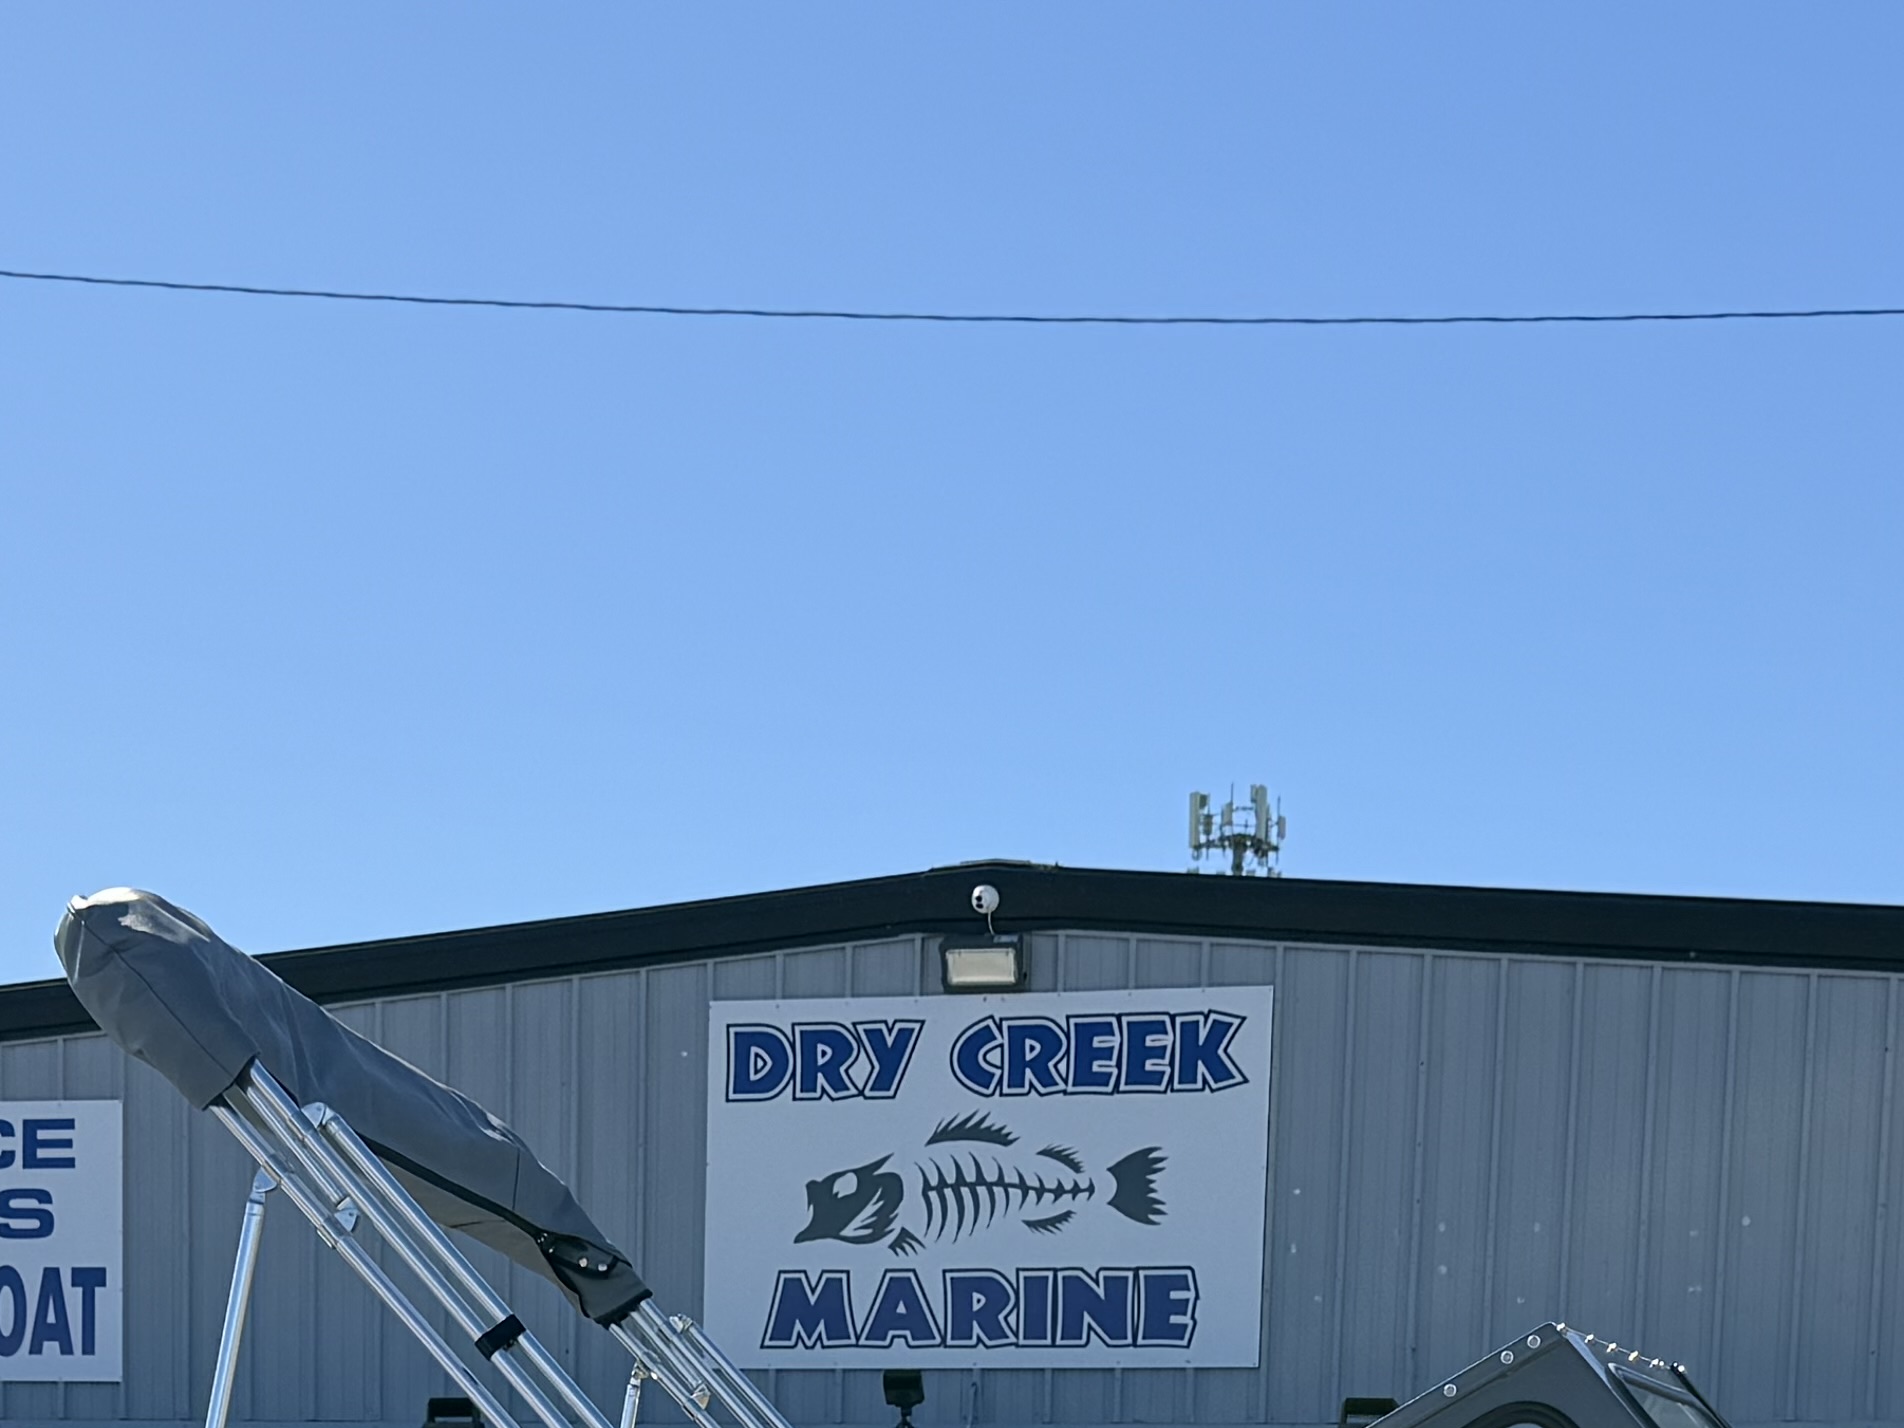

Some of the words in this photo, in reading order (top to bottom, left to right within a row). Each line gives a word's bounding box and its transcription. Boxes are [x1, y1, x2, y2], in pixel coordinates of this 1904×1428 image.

[726, 1019, 926, 1102] DRY
[950, 1009, 1249, 1098] CREEK
[761, 1265, 1200, 1349] MARINE
